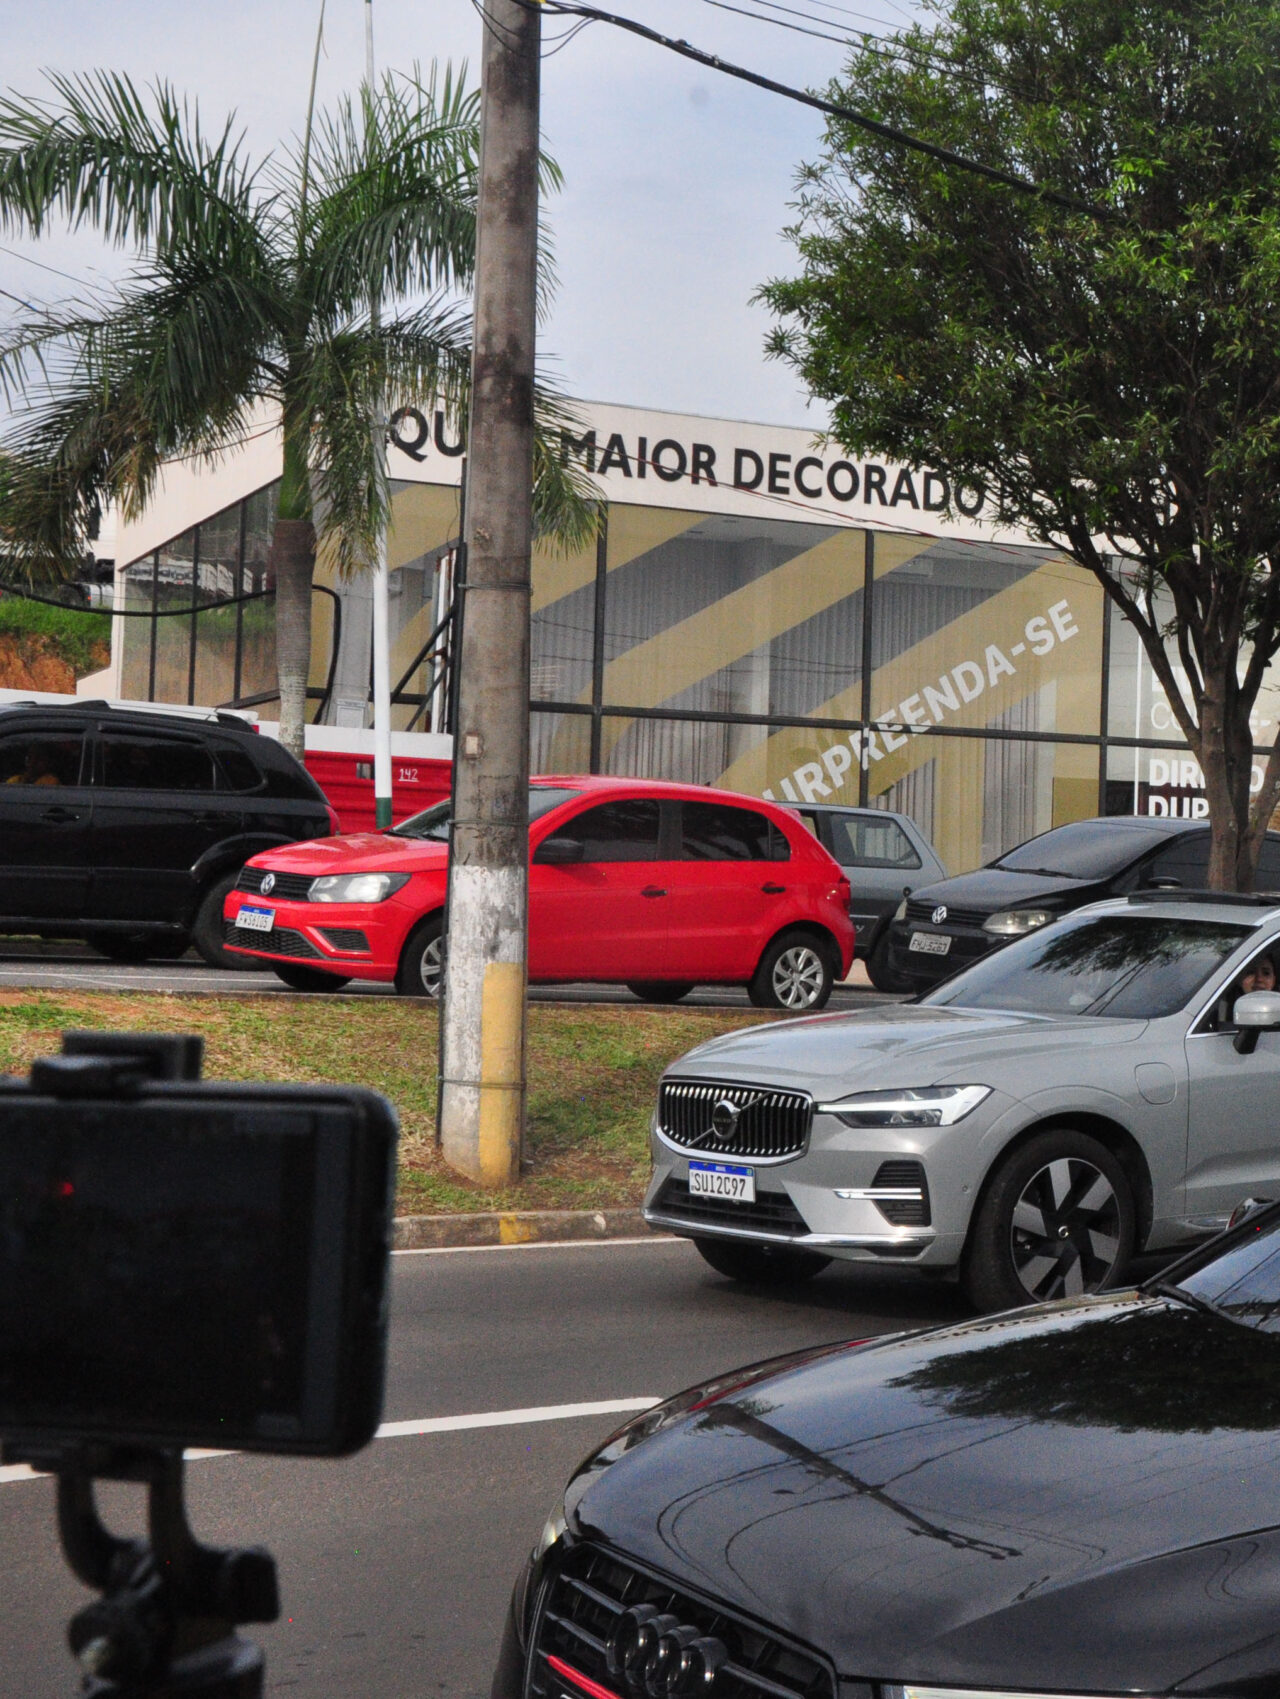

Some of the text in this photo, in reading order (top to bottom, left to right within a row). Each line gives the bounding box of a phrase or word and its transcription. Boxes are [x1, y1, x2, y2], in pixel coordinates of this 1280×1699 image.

[559, 430, 717, 487] MAIOR
[734, 448, 985, 517] DECORADO
[399, 768, 418, 780] 142
